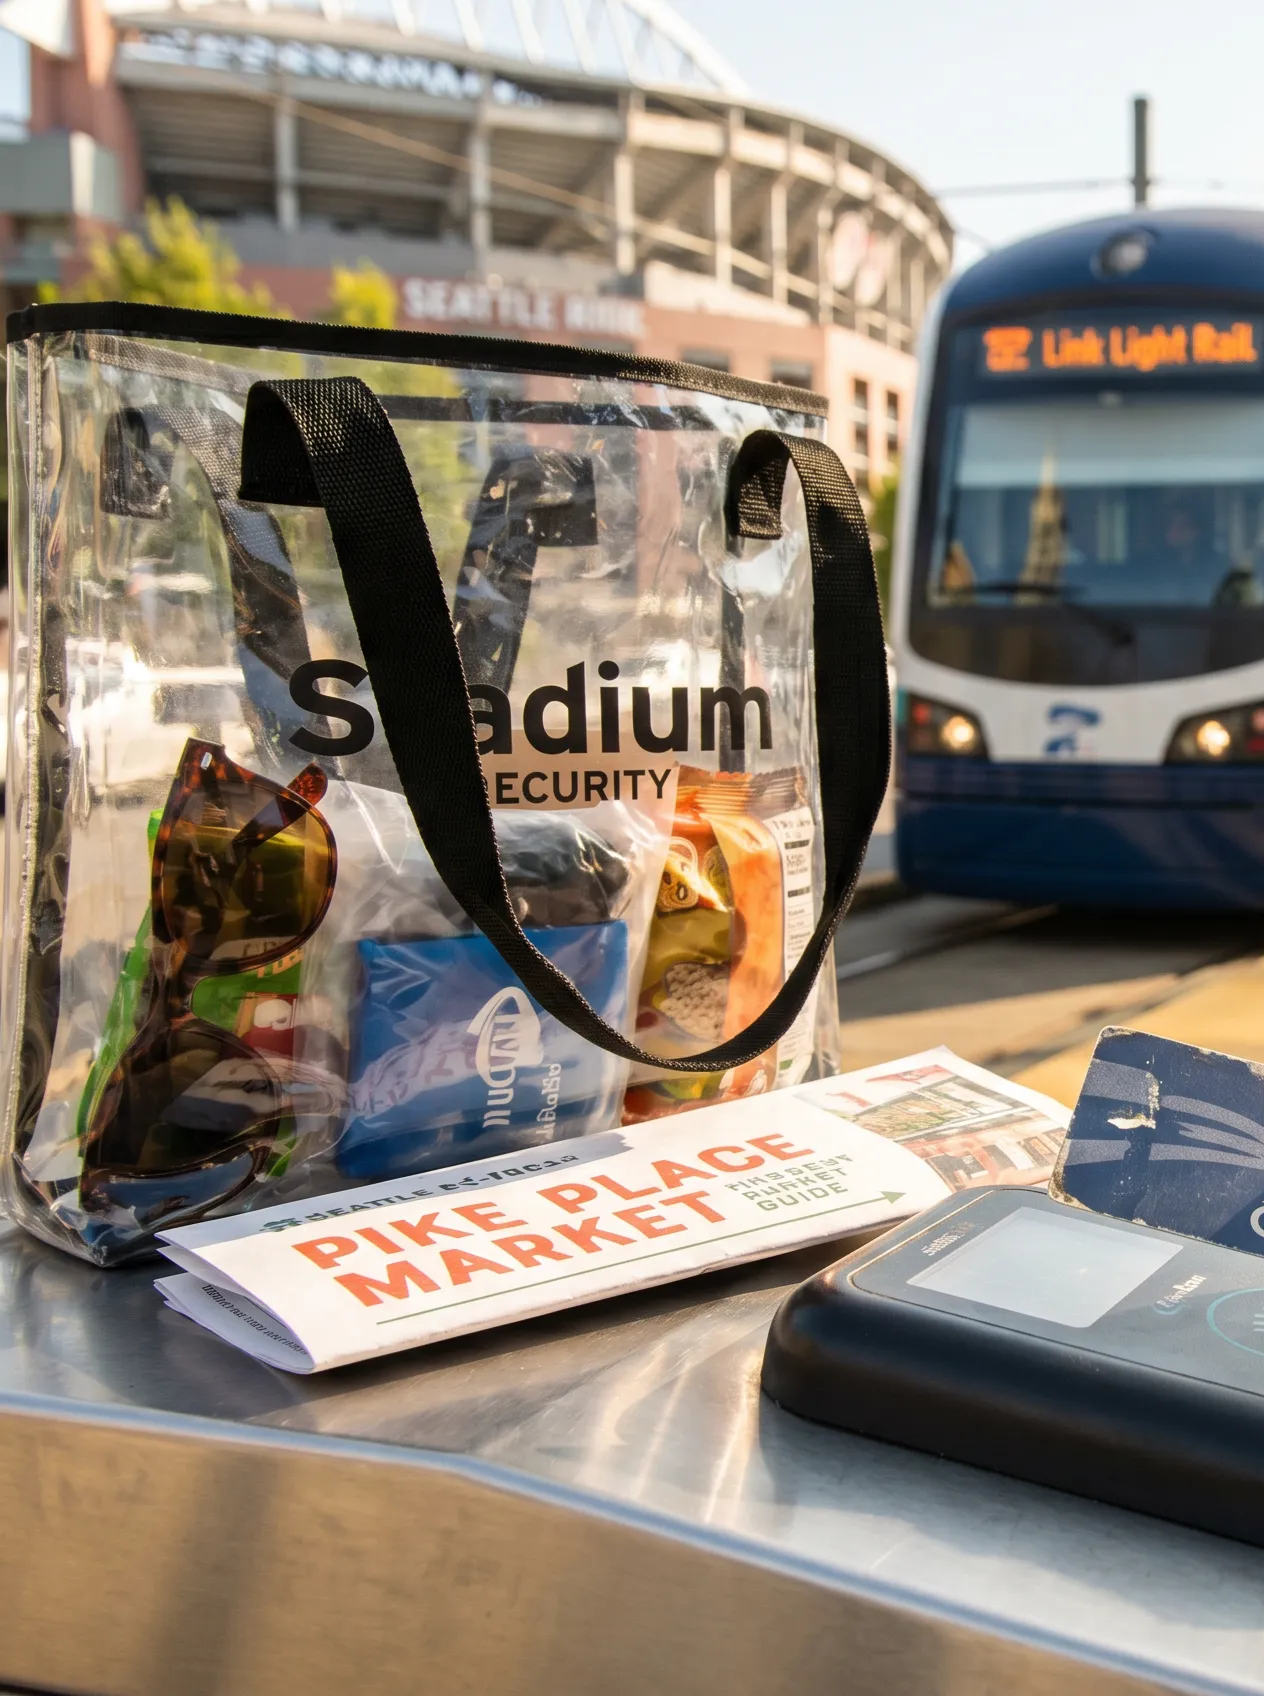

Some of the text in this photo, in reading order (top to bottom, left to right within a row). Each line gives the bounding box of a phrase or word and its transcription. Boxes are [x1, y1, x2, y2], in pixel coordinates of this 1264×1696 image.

[1042, 326, 1105, 368] Link
[1109, 324, 1188, 371] Light
[288, 659, 774, 757] Sadium
[487, 768, 672, 805] ECURITY
[291, 1201, 529, 1270] PIKE
[536, 1133, 815, 1214] PLACE
[756, 1182, 849, 1211] GUIDE
[332, 1190, 727, 1307] MARKET
